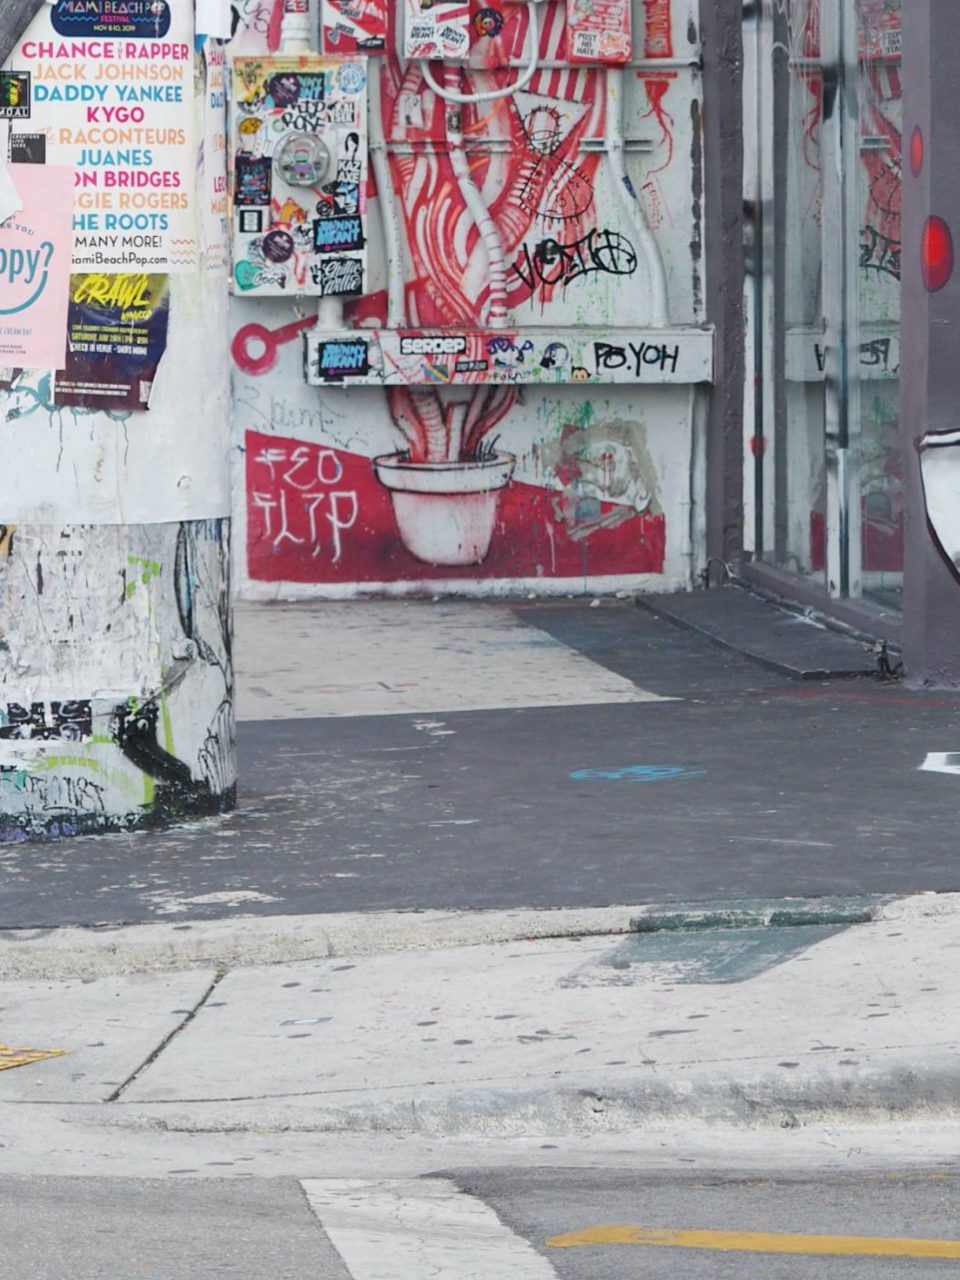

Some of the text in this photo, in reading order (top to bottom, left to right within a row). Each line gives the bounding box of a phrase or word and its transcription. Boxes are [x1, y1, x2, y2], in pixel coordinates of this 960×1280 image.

[58, 0, 102, 13] MIAMI
[105, 0, 143, 14] BEACH
[101, 15, 129, 23] FESTIVAL
[122, 24, 136, 32] 2019
[578, 33, 597, 41] POST
[581, 39, 592, 48] NO
[21, 41, 114, 59] CHANCE
[126, 42, 189, 60] RAPPER
[577, 47, 595, 56] HATE
[33, 63, 184, 81] JACK JOHNSON
[34, 85, 183, 102] DADDY YANKEE
[87, 106, 145, 123] KYGO
[59, 128, 186, 145] RACONTEURS
[77, 149, 153, 166] JUANES
[338, 160, 361, 171] KAZ
[104, 171, 181, 188] BRIDGES
[338, 171, 361, 183] AXE
[119, 192, 188, 209] ROGERS
[105, 214, 168, 230] ROOTS
[75, 235, 162, 248] MANY MORE!
[73, 276, 151, 309] CRAWL
